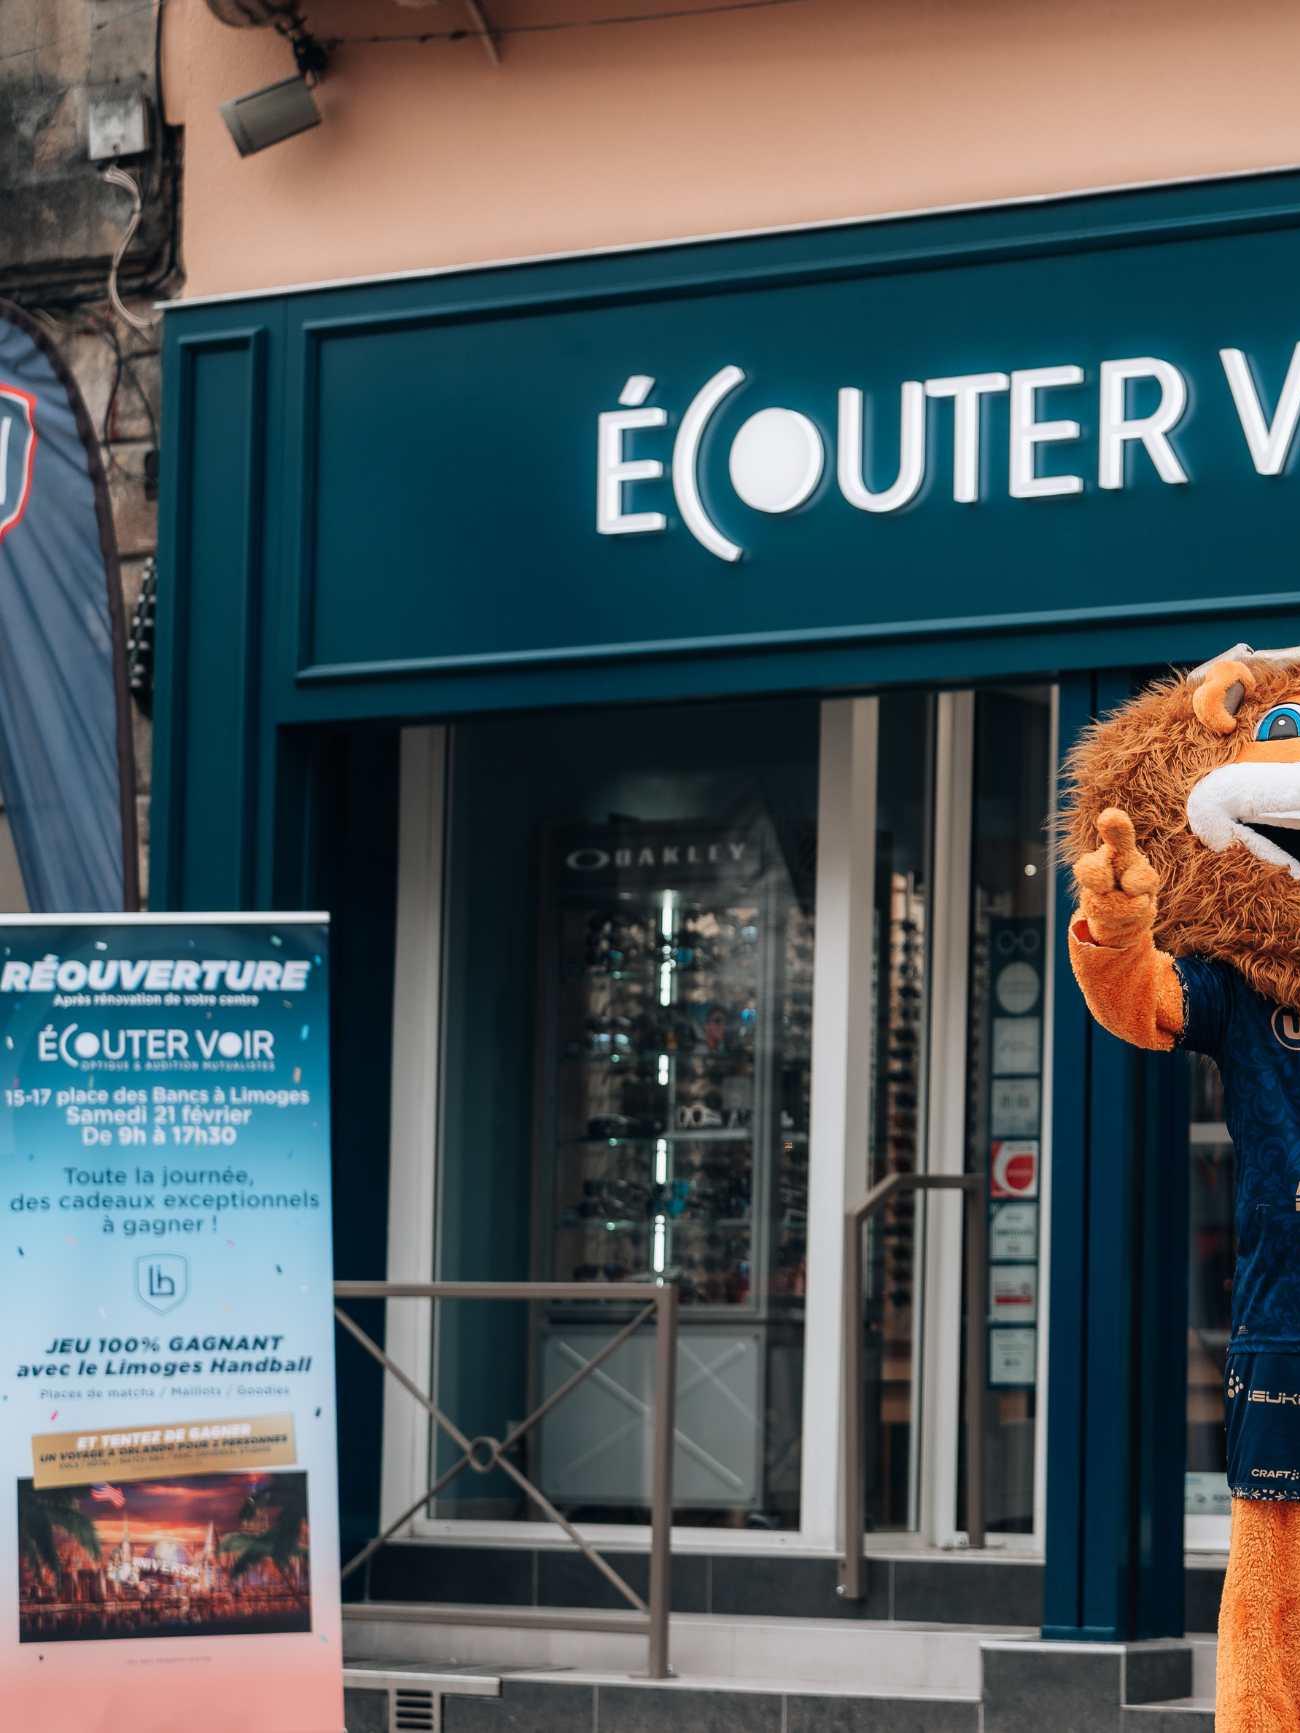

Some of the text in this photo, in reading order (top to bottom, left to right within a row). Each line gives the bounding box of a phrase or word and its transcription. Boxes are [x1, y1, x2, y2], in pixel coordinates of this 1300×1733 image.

[597, 364, 1190, 563] ÉCOUTER
[0, 953, 311, 991] RÉOUVERTURE
[54, 994, 91, 1008] Après
[94, 993, 162, 1006] rénovation
[164, 993, 181, 1006] de
[184, 994, 217, 1006] votre
[38, 1023, 274, 1067] ÉCOUTER VOIR
[5, 1086, 310, 1108] 15-17 place des Bancs à Limoges
[66, 1105, 251, 1125] Samedi 21 février
[82, 1125, 236, 1146] De 9h à 17h30
[63, 1165, 255, 1190] Toute la journée,
[10, 1190, 320, 1212] des cadeaux exceptionnels
[103, 1216, 115, 1234] à
[123, 1218, 204, 1237] gagner
[46, 1335, 284, 1354] JEU 100% GAGNANT
[17, 1356, 312, 1378] avec le Limoges Handball
[77, 1436, 98, 1451] ET
[163, 1427, 185, 1443] DE
[1251, 1469, 1291, 1480] CRAFT
